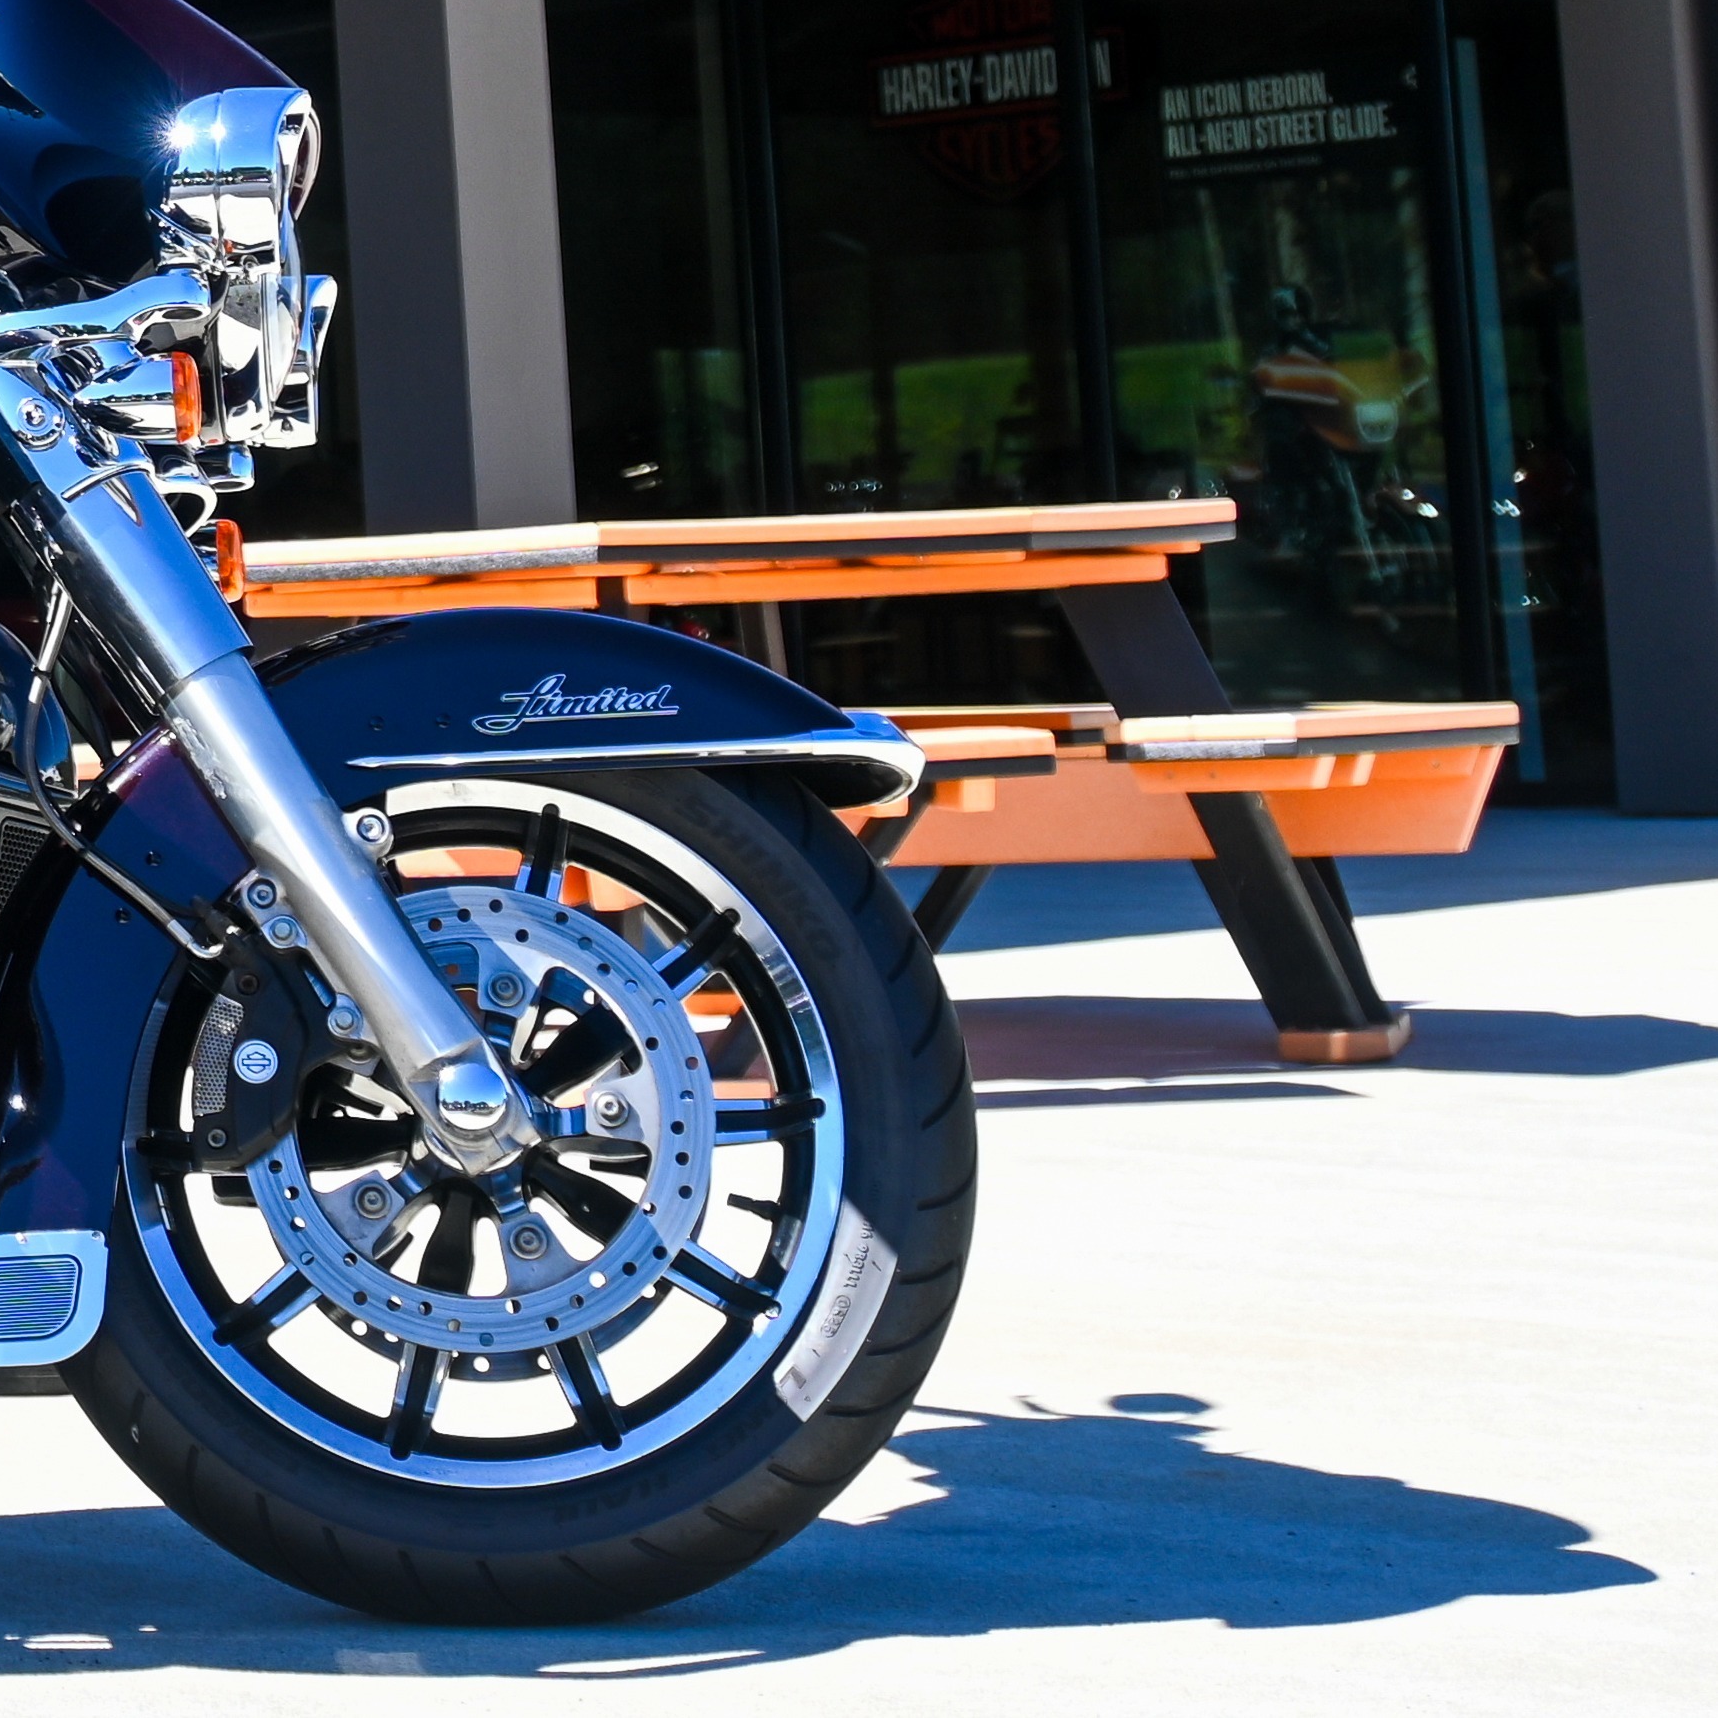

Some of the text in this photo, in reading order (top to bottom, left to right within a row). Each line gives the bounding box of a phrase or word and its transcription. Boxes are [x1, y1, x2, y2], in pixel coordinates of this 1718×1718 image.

[877, 38, 1113, 116] HARLEY-DAVIDN
[1162, 68, 1334, 120] AN ICON REBORN.
[1165, 100, 1398, 158] ALL-NEW STREET GLIDE.
[472, 674, 679, 735] Limited
